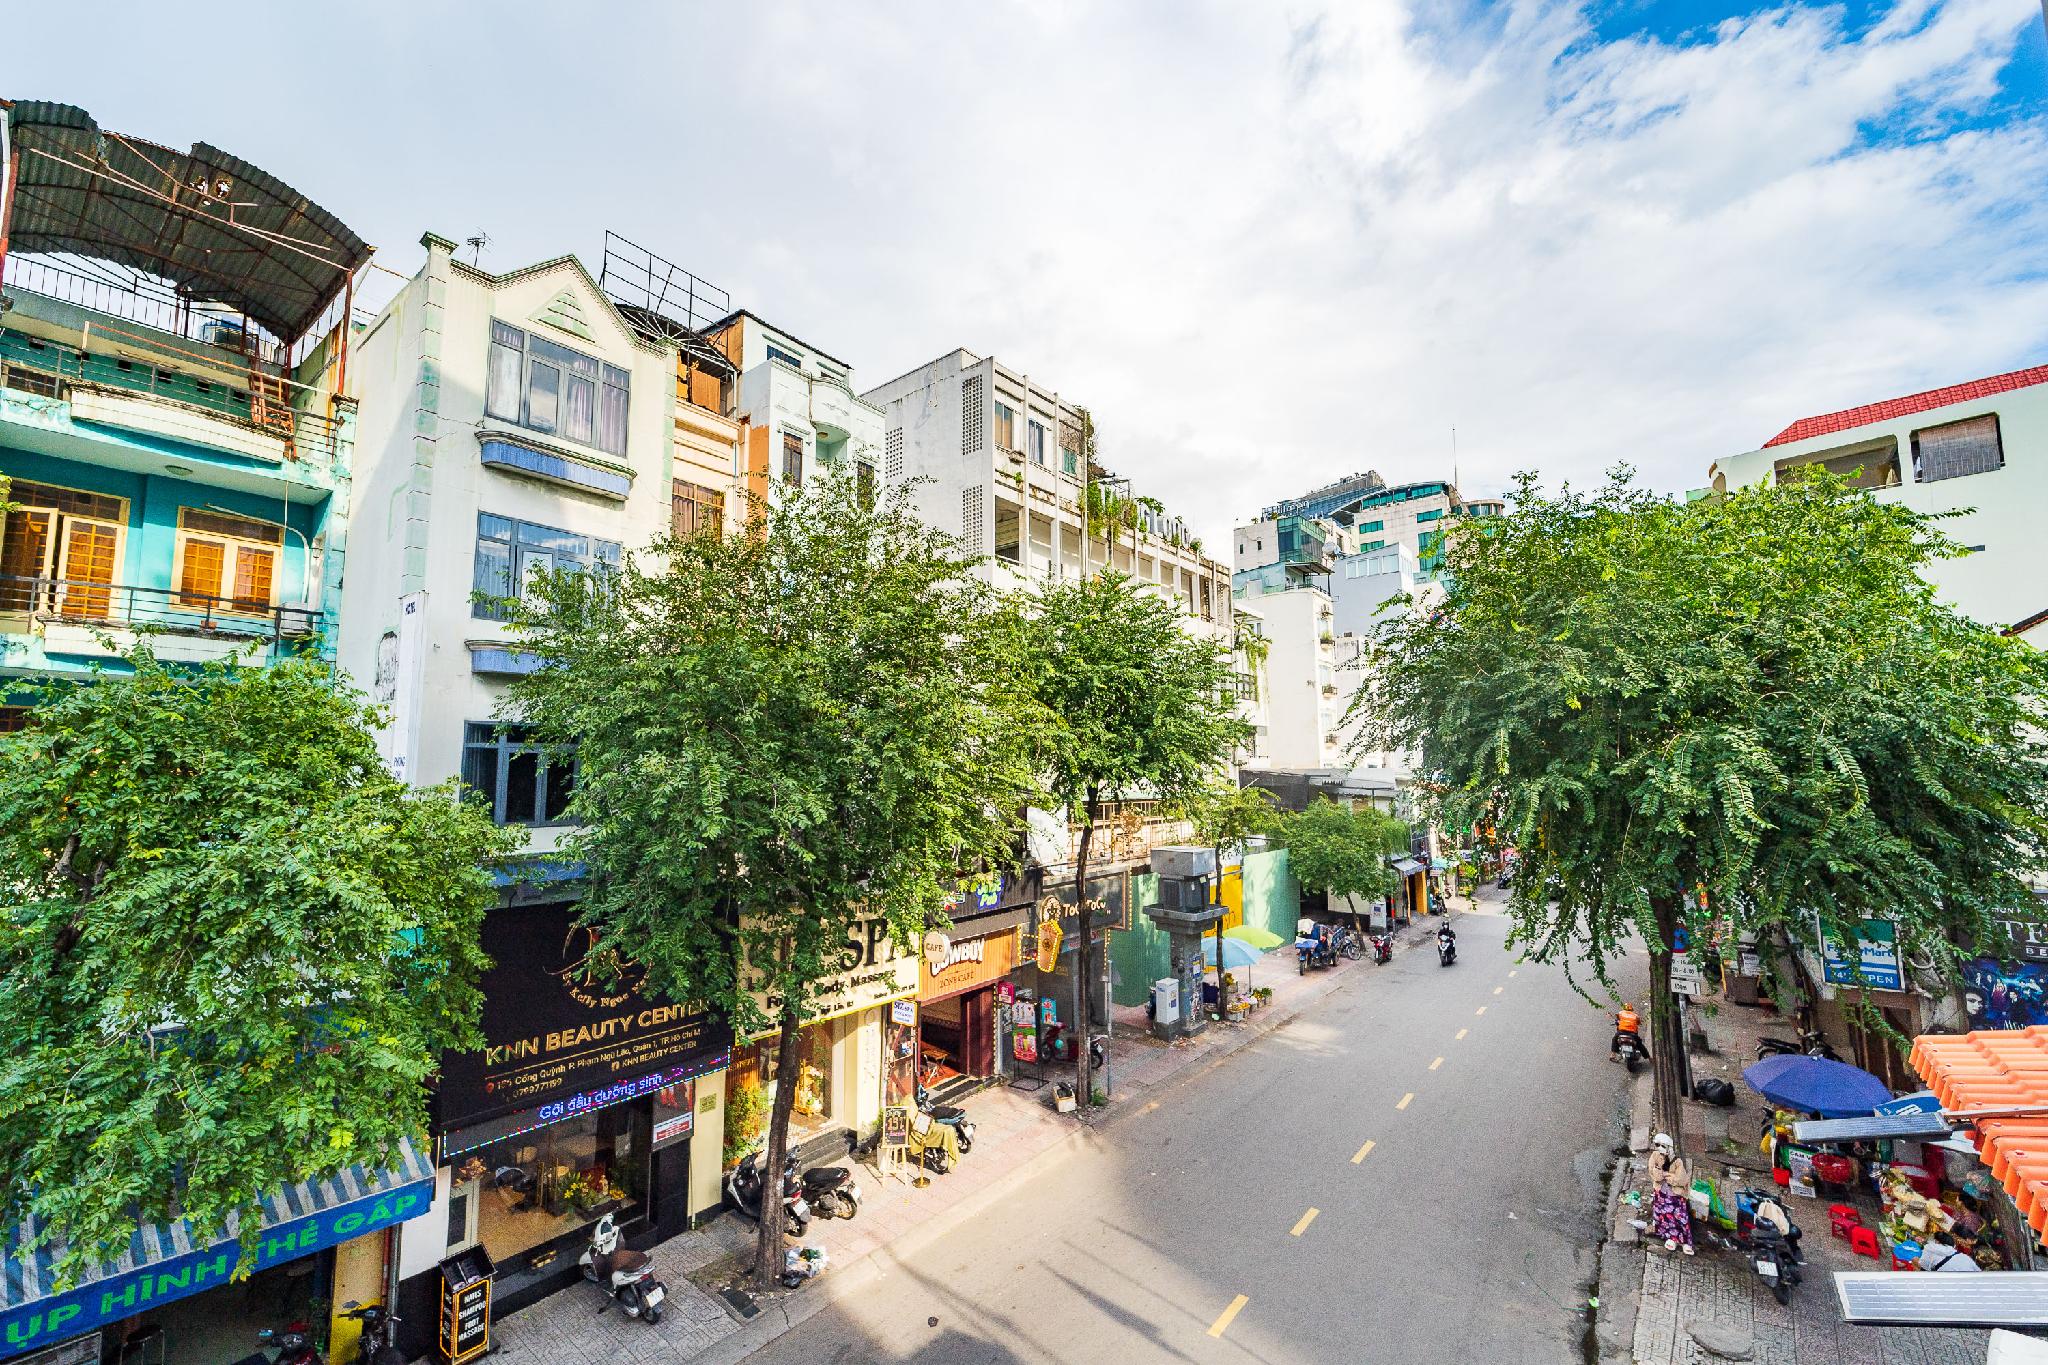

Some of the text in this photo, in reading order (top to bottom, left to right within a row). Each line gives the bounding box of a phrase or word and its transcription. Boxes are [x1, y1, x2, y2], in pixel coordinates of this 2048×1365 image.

[926, 943, 943, 952] CAFE
[486, 1035, 540, 1066] KNN
[546, 1014, 634, 1052] BEAUTY
[622, 1056, 639, 1068] KNN
[640, 1047, 669, 1063] BEAUTY
[639, 1073, 663, 1090] sinh
[100, 1254, 228, 1316] HÌNH
[332, 1192, 418, 1235] GẤP
[464, 1316, 480, 1331] FOOT
